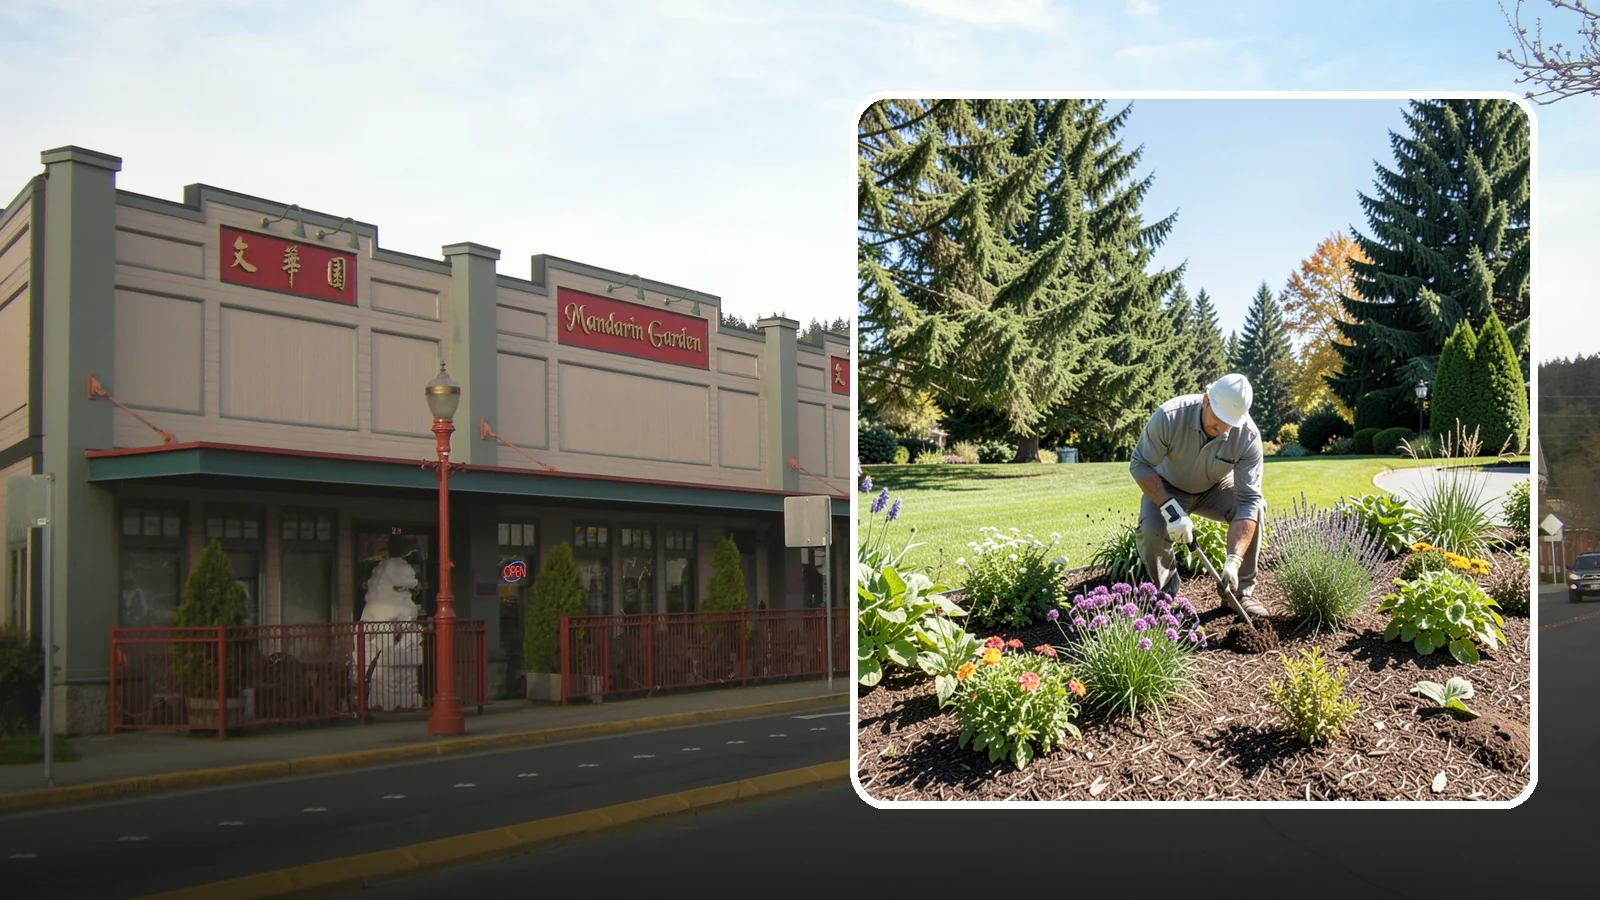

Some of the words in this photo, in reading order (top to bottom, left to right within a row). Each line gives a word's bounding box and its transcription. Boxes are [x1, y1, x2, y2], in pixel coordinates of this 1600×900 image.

[231, 236, 346, 290] 文華園
[565, 302, 643, 340] Mandarin
[648, 320, 701, 352] Garden
[503, 565, 526, 578] OPEN
